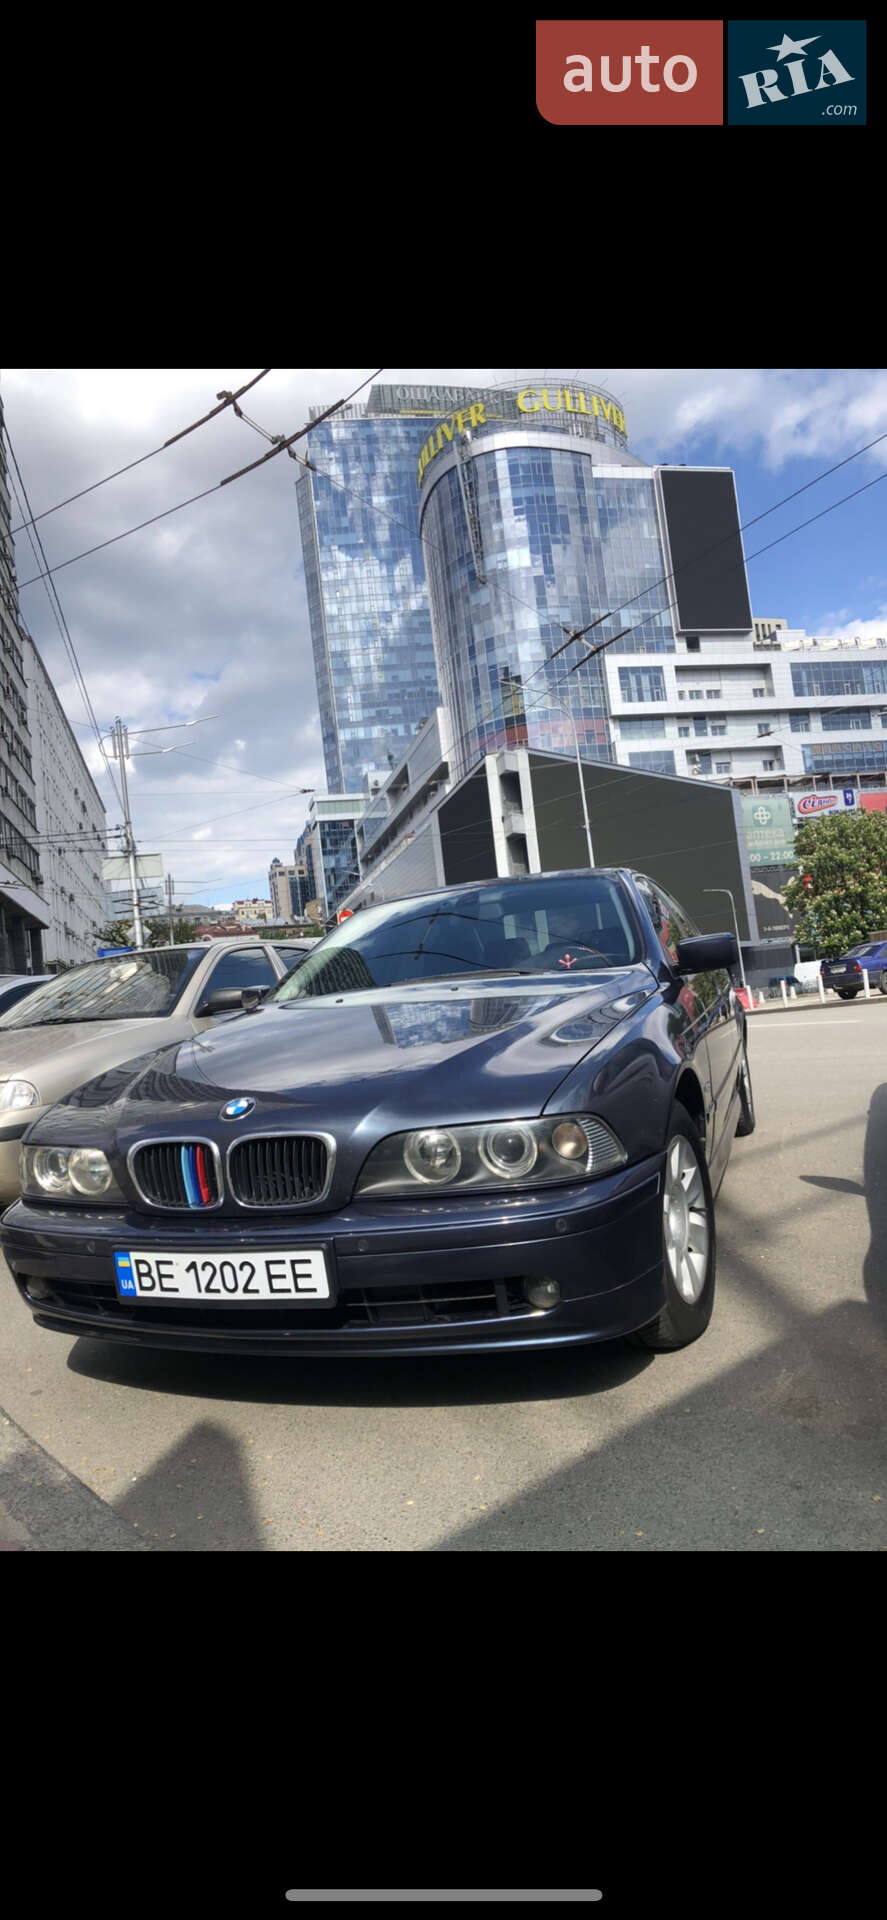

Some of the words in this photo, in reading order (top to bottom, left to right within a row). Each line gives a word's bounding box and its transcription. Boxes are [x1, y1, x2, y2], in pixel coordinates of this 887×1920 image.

[517, 388, 627, 437] GULLIVER
[121, 1280, 135, 1290] UA
[133, 1259, 180, 1293] BE
[185, 1260, 261, 1294] 1202
[265, 1259, 318, 1294] EE
